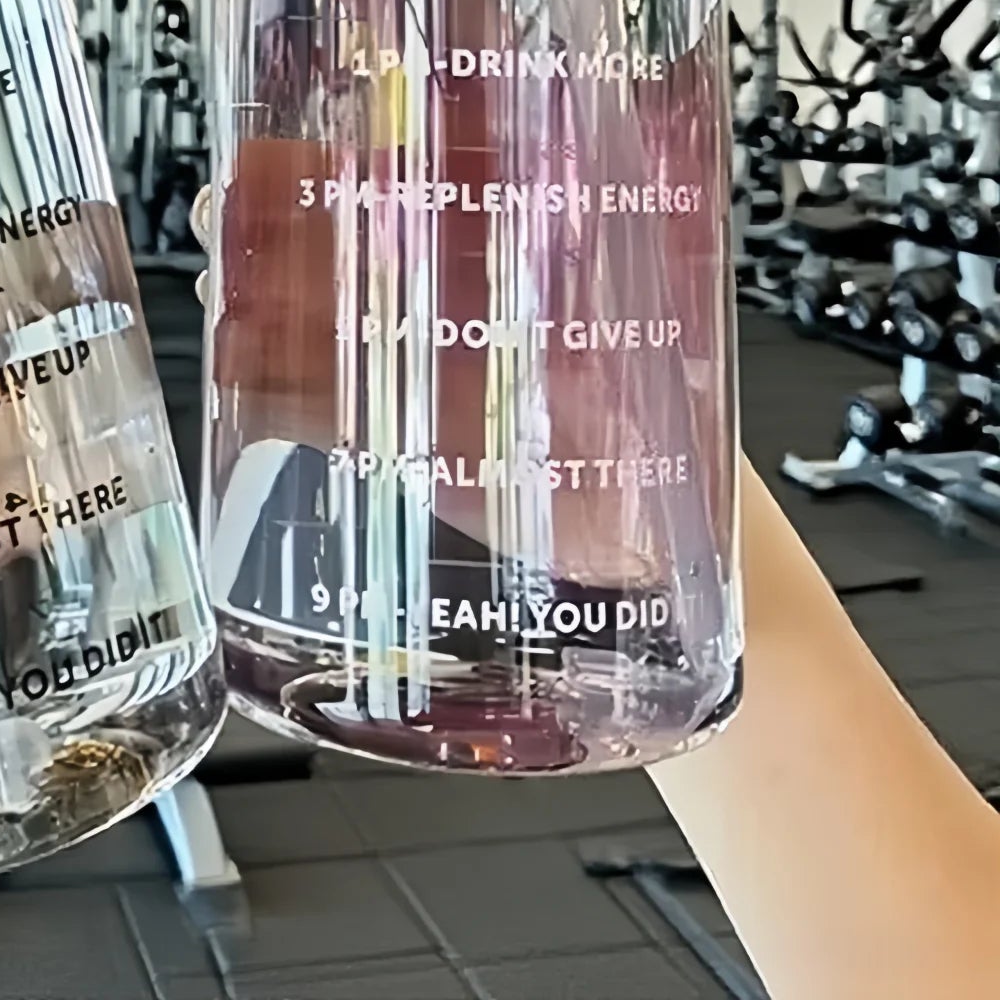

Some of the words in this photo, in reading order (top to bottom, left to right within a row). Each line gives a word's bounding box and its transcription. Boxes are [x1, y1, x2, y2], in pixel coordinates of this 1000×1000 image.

[379, 48, 568, 78] P-DRINK
[577, 51, 663, 82] MORE
[299, 178, 315, 207] 3
[562, 319, 641, 350] GIVE
[649, 320, 682, 347] UP
[54, 339, 92, 377] UP
[311, 584, 331, 613] 9
[529, 600, 607, 635] YOU
[615, 598, 670, 630] DID
[80, 626, 138, 678] DID
[137, 609, 164, 650] IT
